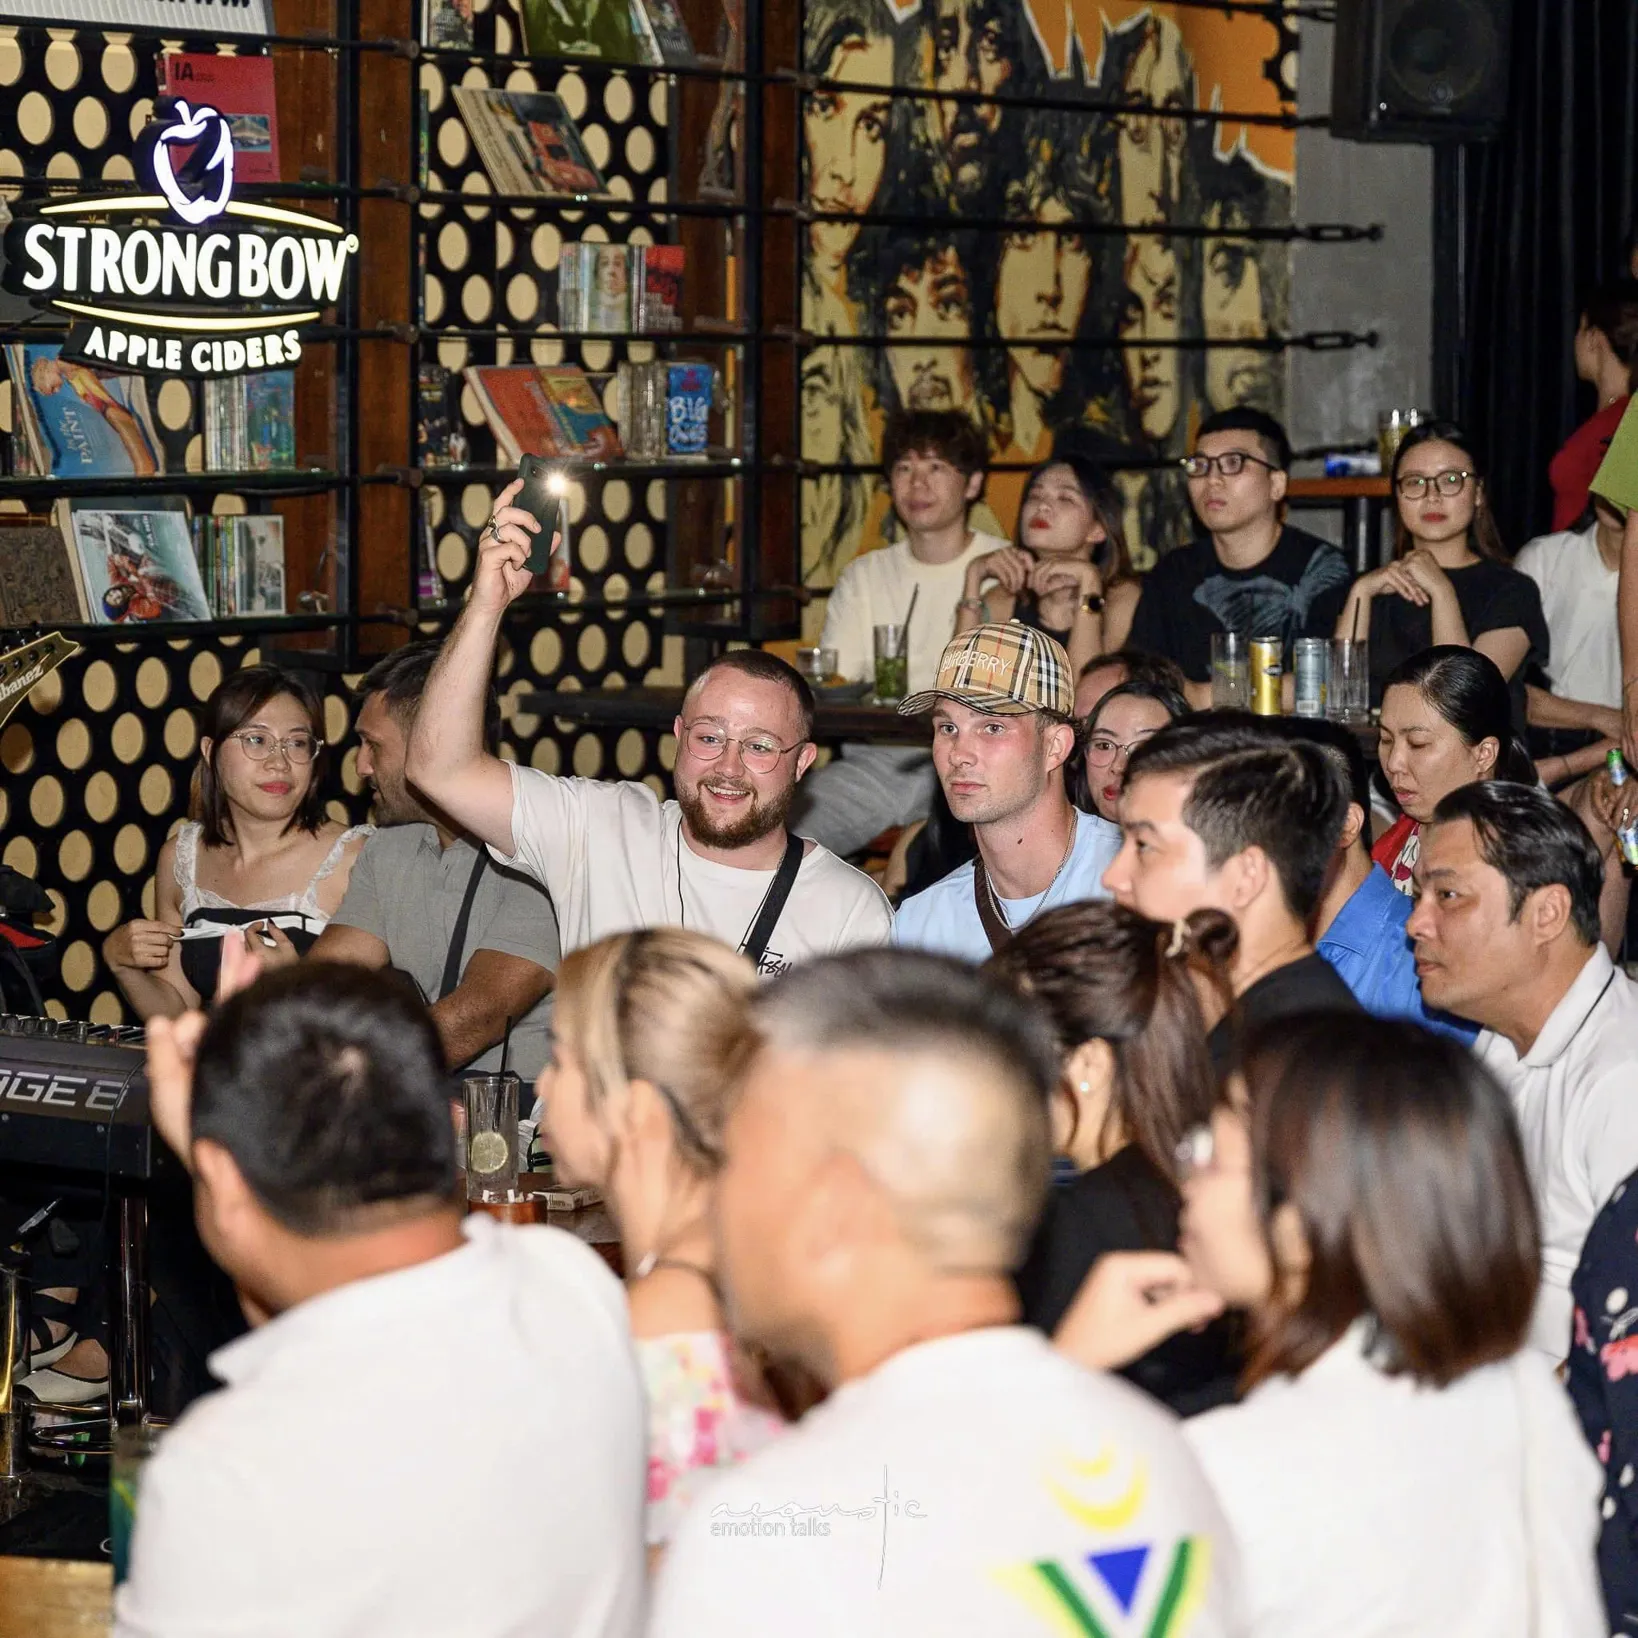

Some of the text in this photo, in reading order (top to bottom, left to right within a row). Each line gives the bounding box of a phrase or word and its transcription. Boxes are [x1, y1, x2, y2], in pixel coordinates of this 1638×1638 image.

[22, 223, 348, 301] STRONGBOW
[84, 326, 302, 373] APPLE CIDERS
[0, 664, 44, 702] banez
[0, 1069, 88, 1107] GE
